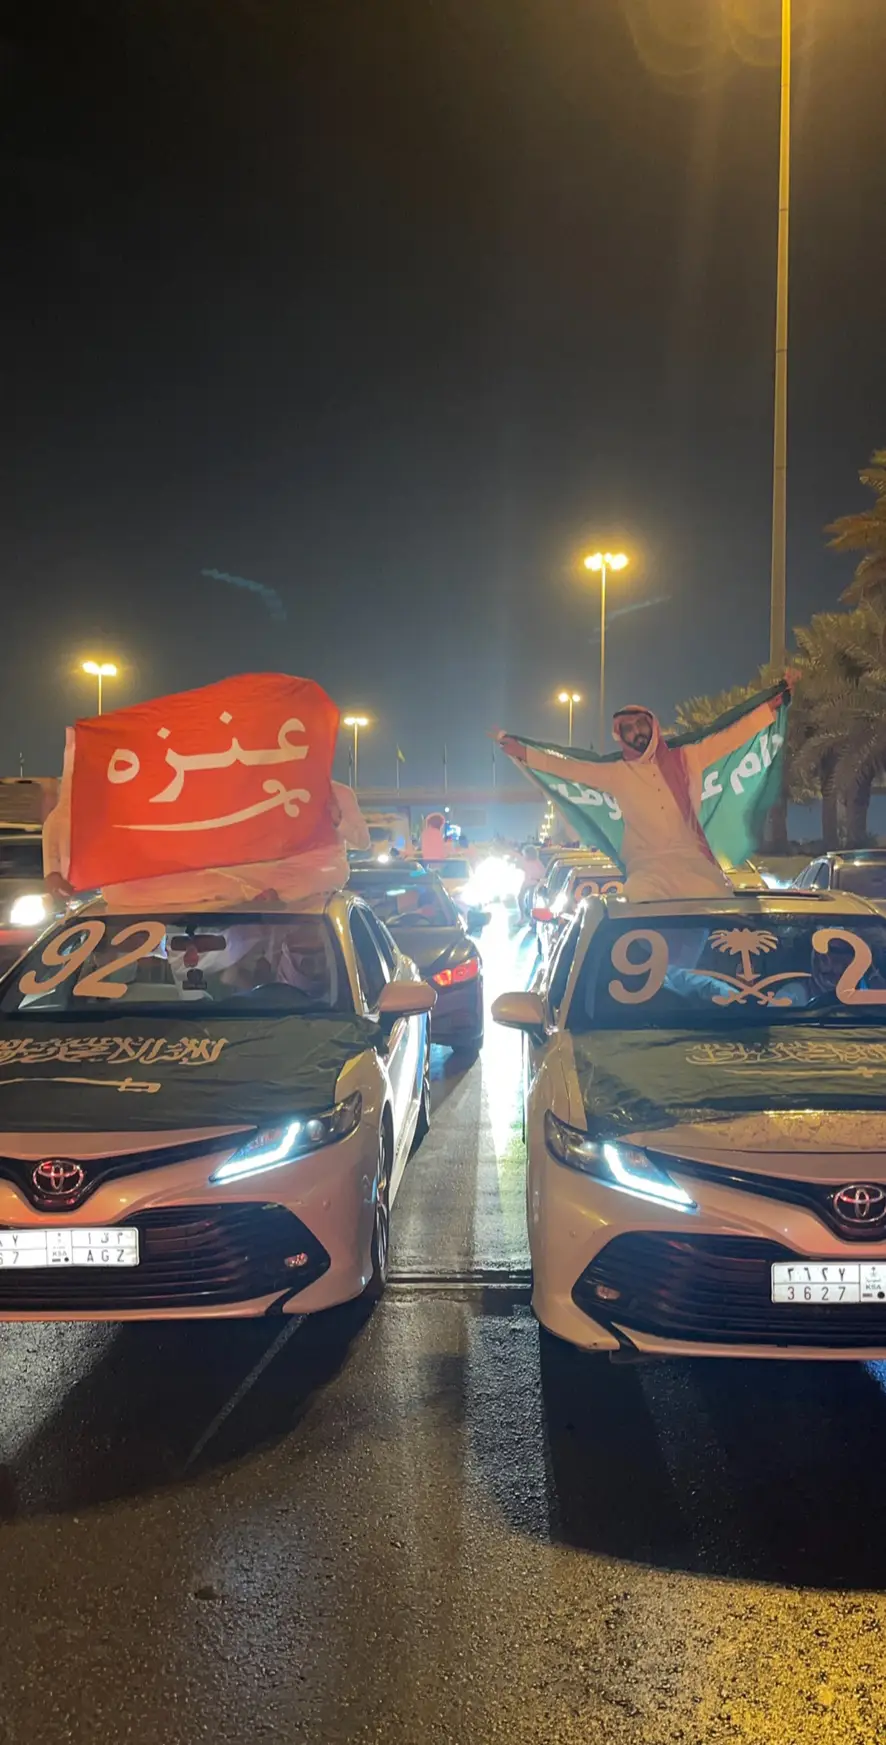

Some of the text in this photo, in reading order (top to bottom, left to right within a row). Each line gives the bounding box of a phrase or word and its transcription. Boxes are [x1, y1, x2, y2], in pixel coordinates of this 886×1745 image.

[107, 711, 309, 803] عنزه
[18, 920, 166, 999] 92
[787, 1286, 846, 1301] 3627
